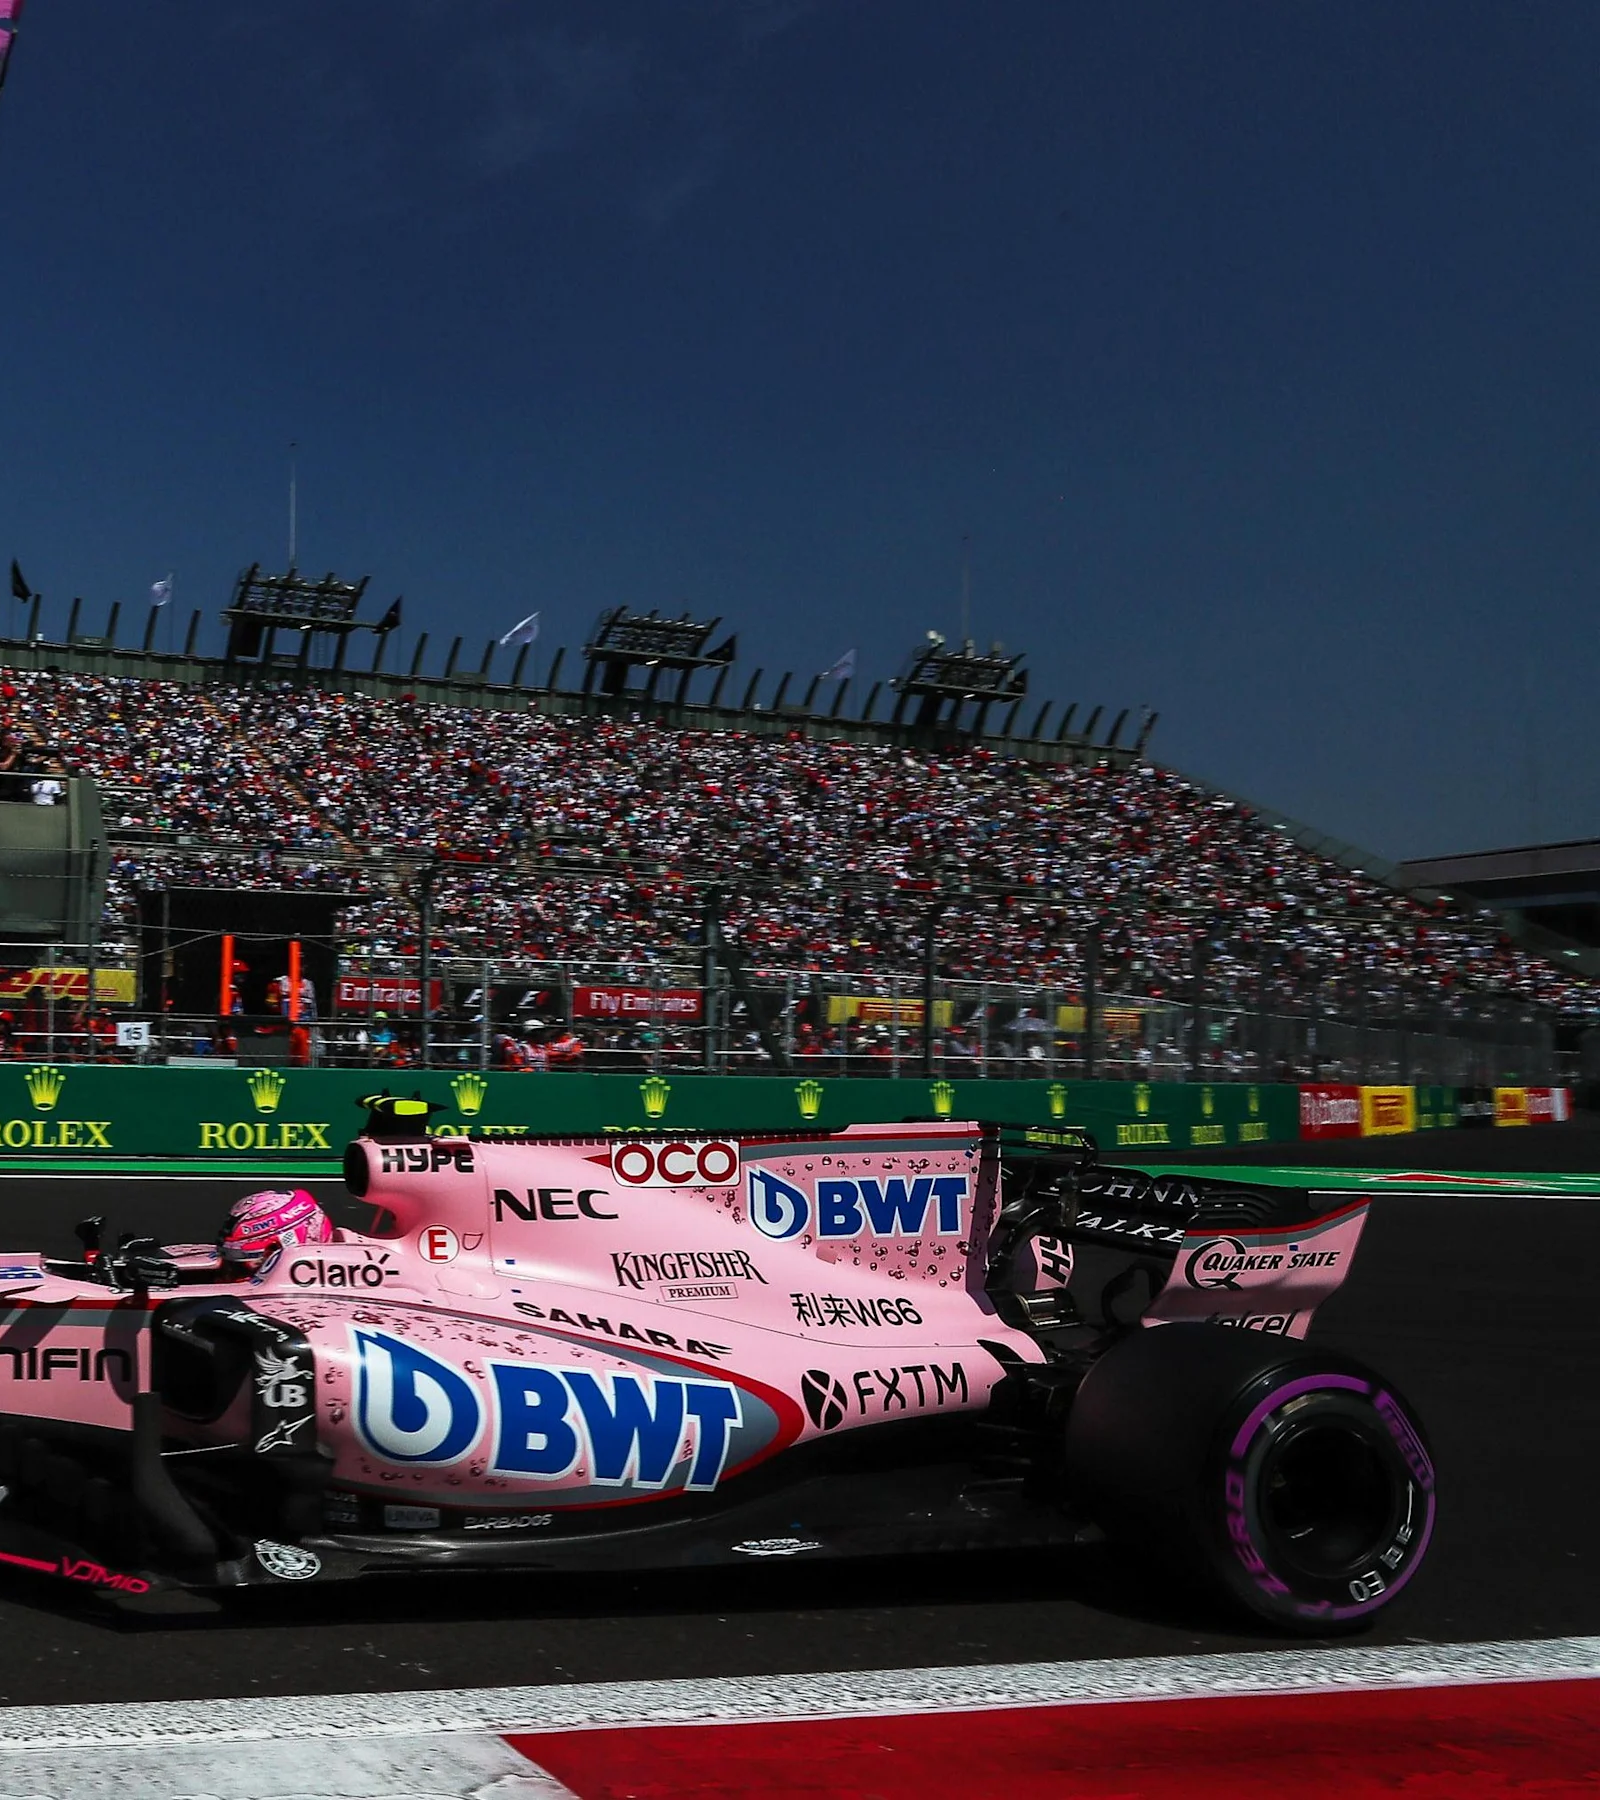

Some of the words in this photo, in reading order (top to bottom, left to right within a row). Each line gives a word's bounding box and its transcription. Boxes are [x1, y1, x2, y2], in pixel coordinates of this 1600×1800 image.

[123, 1027, 143, 1041] 15
[199, 1122, 332, 1151] ROLEX
[382, 1148, 474, 1173] HYPE
[614, 1142, 737, 1184] OCO
[495, 1188, 619, 1222] NEC
[815, 1174, 970, 1240] BWT
[429, 1230, 448, 1260] E
[290, 1257, 384, 1288] Claro
[611, 1249, 769, 1290] KINGFISHER
[1202, 1252, 1281, 1272] QUAKER
[1287, 1251, 1340, 1270] STATE
[669, 1286, 732, 1299] PREMIUM
[790, 1293, 923, 1327] 利来W66
[513, 1302, 732, 1360] SAHARA
[853, 1362, 969, 1415] FXTM
[482, 1357, 744, 1492] BWT
[463, 1513, 554, 1530] BARBADOS
